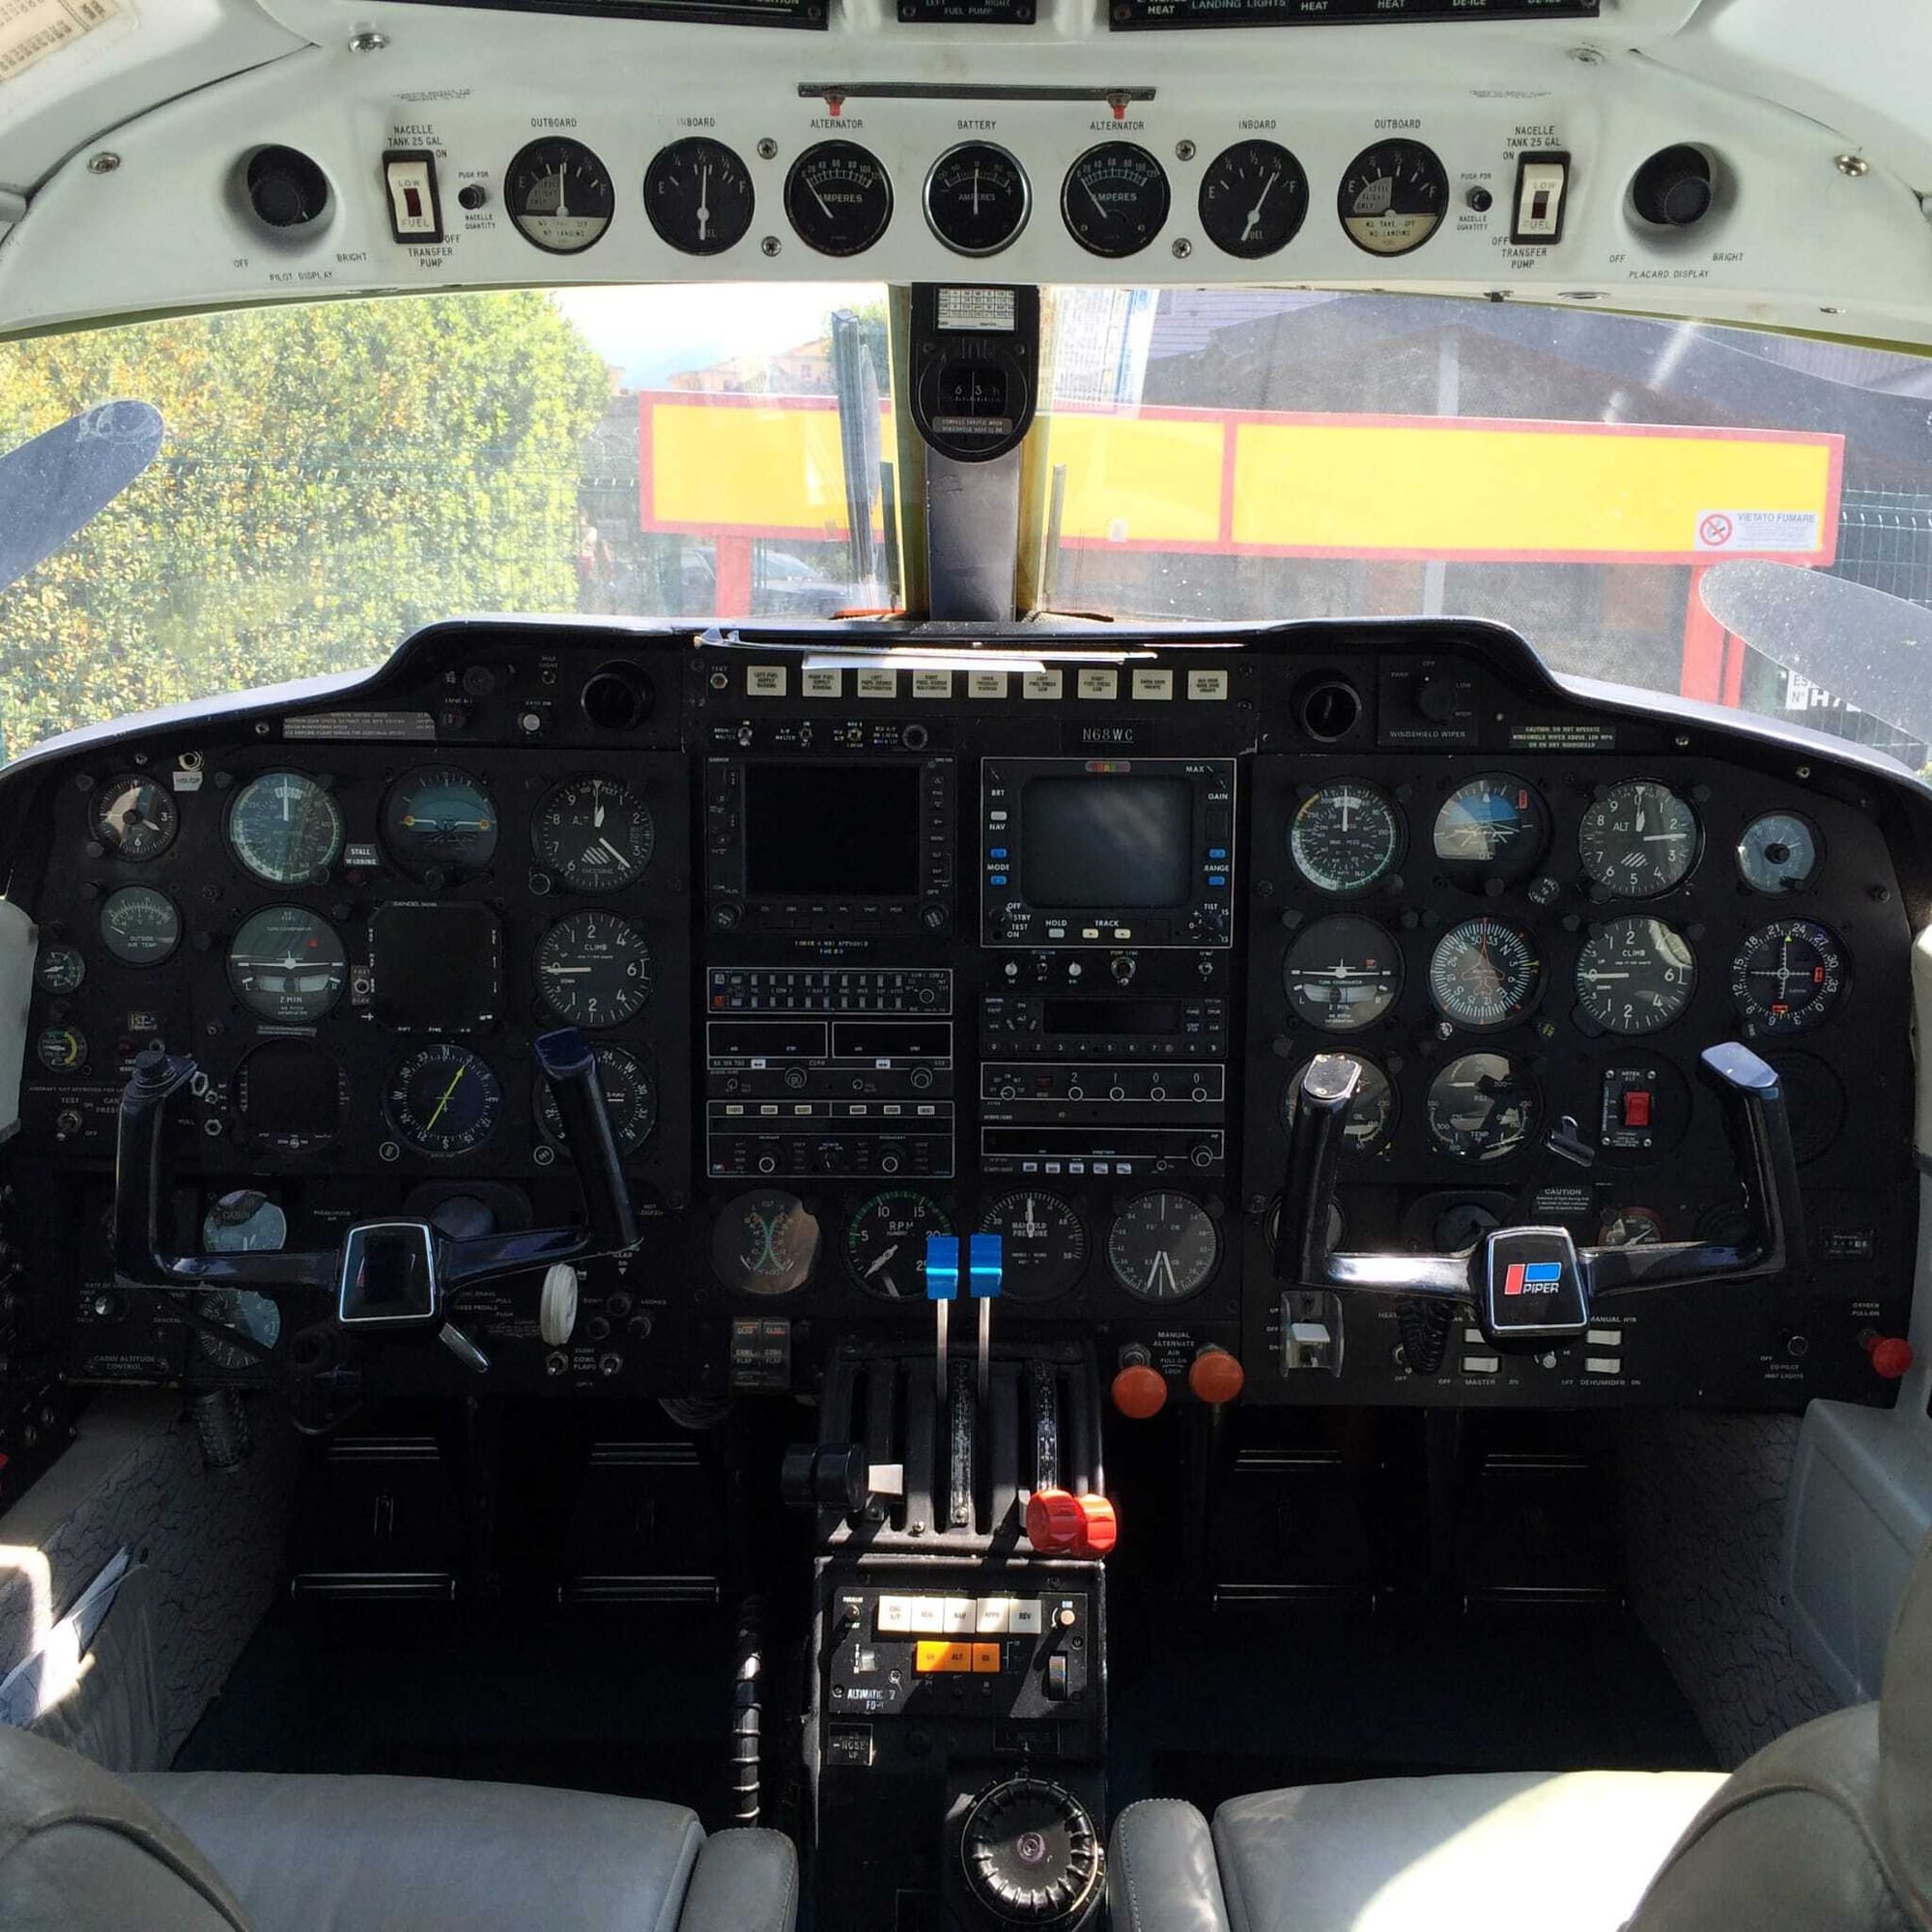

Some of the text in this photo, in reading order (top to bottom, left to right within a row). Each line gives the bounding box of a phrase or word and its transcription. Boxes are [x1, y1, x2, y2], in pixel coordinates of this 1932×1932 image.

[1147, 5, 1176, 14] HEAT
[1300, 1, 1328, 11] HEAT
[1378, 0, 1405, 9] HEAT
[943, 7, 993, 15] FUEL PUMP
[530, 118, 577, 128] OUTBOARD
[810, 119, 864, 129] ALTERNATOR
[957, 120, 997, 130] BATTERY
[1090, 122, 1145, 130] ALTERNATOR
[1238, 120, 1276, 129] INBOARD
[1374, 119, 1421, 129] OUTBOARD
[394, 125, 434, 135] NACELLE
[1515, 126, 1554, 135] NACELLE
[388, 136, 442, 147] TANK 25 GAL
[1507, 138, 1528, 147] TANK
[1546, 137, 1561, 147] GAL
[436, 149, 447, 158] ON
[1503, 151, 1515, 160] ON
[398, 179, 420, 188] LOW
[1533, 182, 1555, 190] LOW
[401, 217, 430, 228] FUEL
[465, 213, 494, 222] NACELLE
[465, 222, 497, 231] QUANTITY
[1456, 223, 1489, 232] QUANTITY
[1523, 220, 1550, 231] FUEL
[445, 234, 461, 243] OFF
[1492, 237, 1508, 246] OFF
[336, 251, 368, 264] BRIGHT
[408, 247, 454, 258] TRANSFER
[1501, 247, 1548, 258] TRANSFER
[1712, 251, 1745, 262] BRIGHT
[233, 258, 250, 269] OFF
[420, 258, 443, 269] PUMP
[1608, 254, 1626, 263] OFF
[1511, 260, 1535, 270] PUMP
[270, 270, 333, 281] PILOT DISPLAY
[1629, 270, 1711, 279] PLACARD DISPLAY
[1738, 513, 1816, 525] VIETATO FUMARE
[991, 788, 1006, 797] BRT
[1208, 792, 1228, 801] GAIN
[567, 794, 577, 806] 9
[1610, 800, 1619, 812] 9
[1596, 814, 1605, 827] 8
[1669, 818, 1678, 830] 2
[989, 823, 1006, 832] NAV
[1613, 822, 1630, 832] ALT
[350, 847, 371, 856] STALL
[1606, 866, 1615, 877] 6
[1630, 872, 1638, 885] 5
[1007, 902, 1021, 911] OFF
[1204, 902, 1218, 911] TILT
[1011, 923, 1028, 931] TEST
[1045, 919, 1067, 927] HOLD
[587, 923, 596, 939] 2
[1007, 930, 1020, 939] ON
[1768, 923, 1781, 936] 21
[1792, 923, 1806, 935] 24
[1627, 931, 1636, 946] 2
[1744, 934, 1758, 949] 18
[1813, 933, 1829, 946] 27
[583, 943, 608, 952] CLIMB
[1498, 946, 1511, 957] N
[1733, 957, 1745, 971] 15
[1826, 953, 1840, 968] 30
[626, 962, 638, 977] 6
[1664, 967, 1674, 982] 6
[1731, 982, 1744, 996] 12
[1826, 980, 1840, 994] 33
[616, 988, 626, 1002] 4
[588, 997, 597, 1012] 2
[1653, 994, 1663, 1008] 4
[1623, 1004, 1634, 1018] 2
[1070, 1072, 1078, 1084] 2
[1152, 1072, 1159, 1083] 0
[1193, 1073, 1200, 1084] 0
[1545, 1188, 1582, 1197] CAUTION
[877, 1206, 891, 1218] 10
[913, 1206, 926, 1218] 15
[889, 1221, 914, 1232] RPM
[861, 1230, 869, 1242] 5
[1522, 1283, 1560, 1295] PIPER
[1590, 1314, 1622, 1322] MANUAL
[1156, 1330, 1191, 1339] MANUAL
[1464, 1378, 1496, 1386] MASTER
[846, 1688, 883, 1700] ALTIMATIC
[841, 1740, 866, 1750] NOSE
